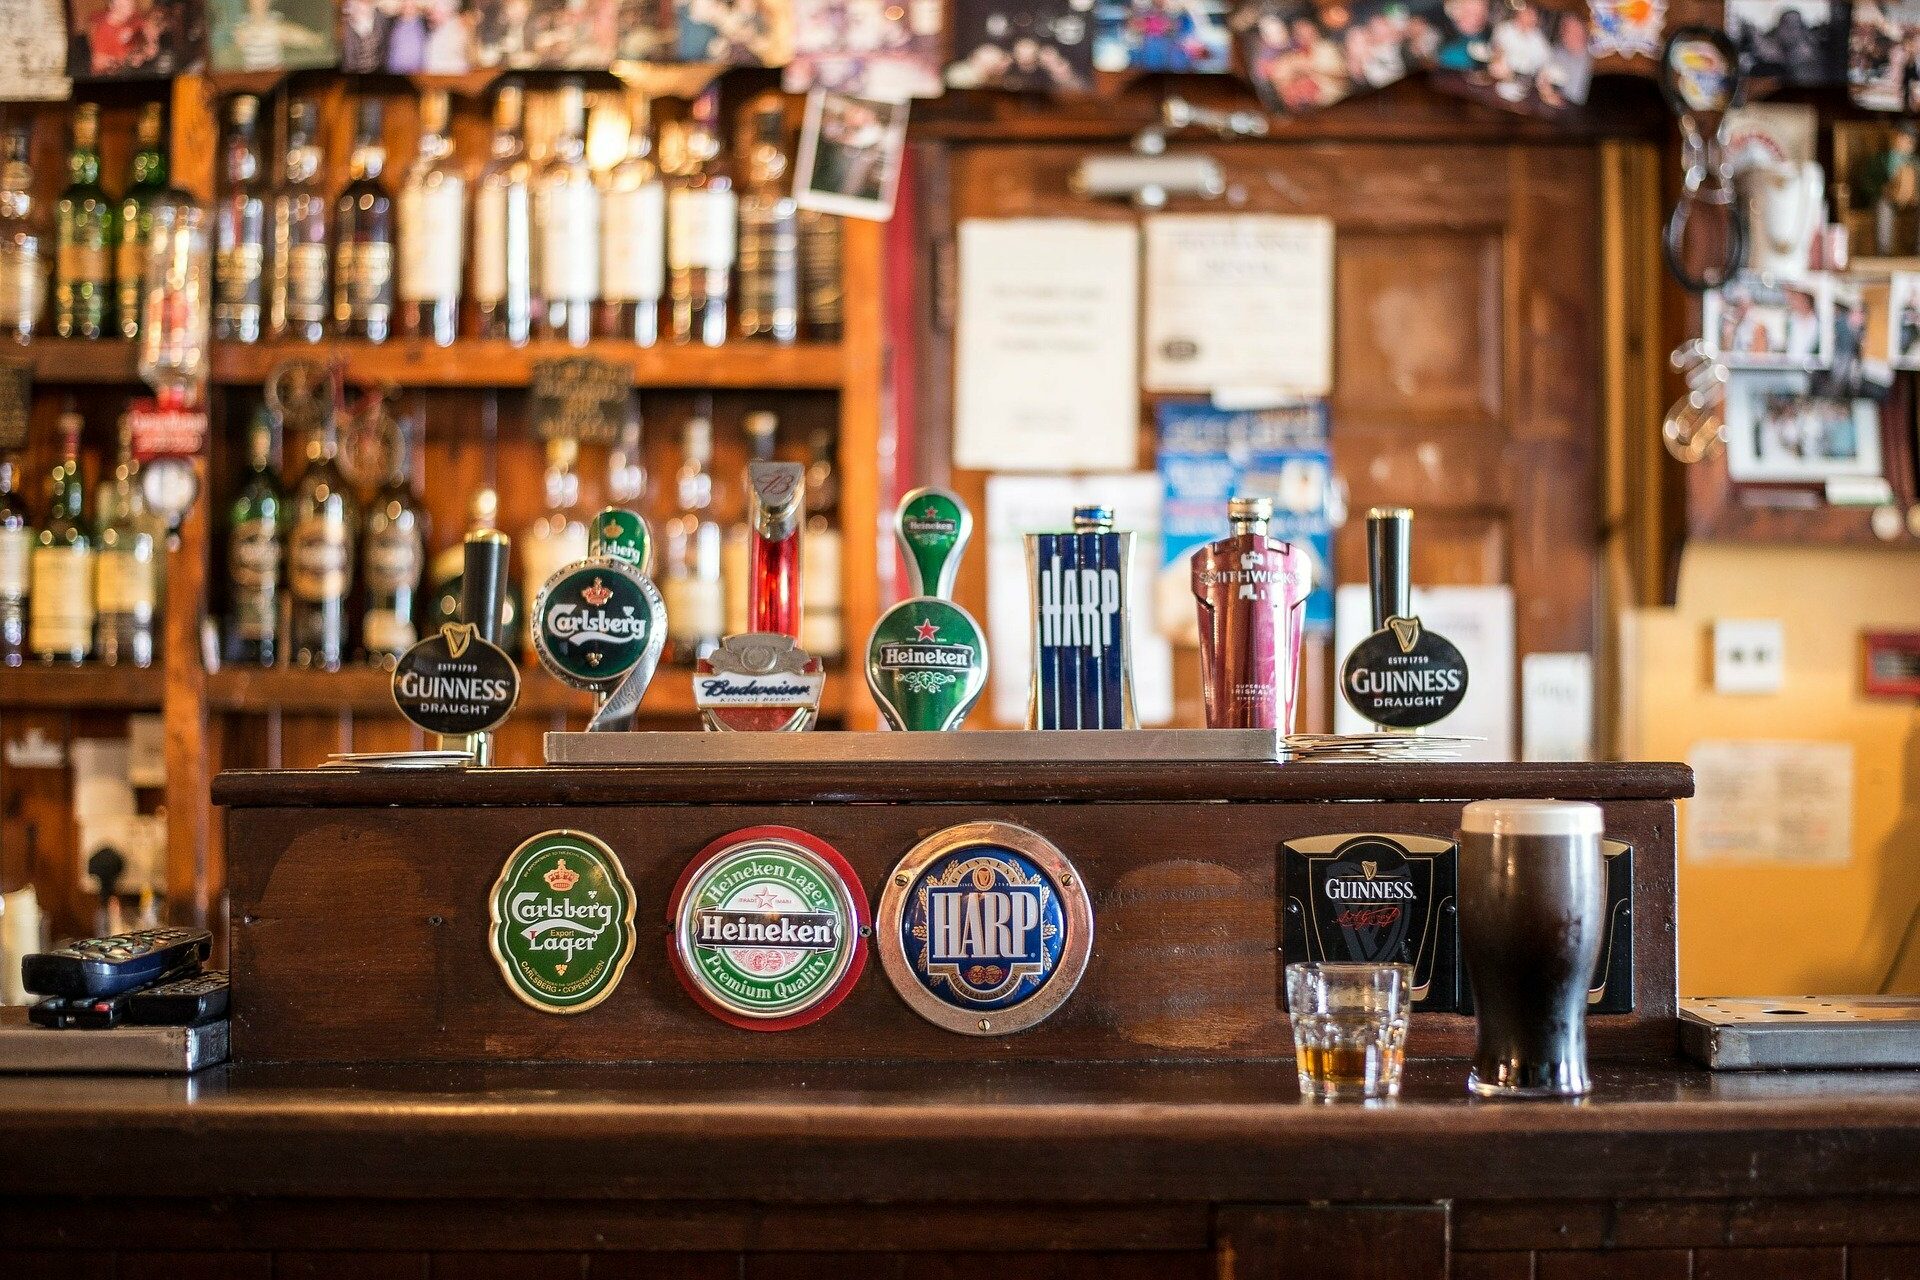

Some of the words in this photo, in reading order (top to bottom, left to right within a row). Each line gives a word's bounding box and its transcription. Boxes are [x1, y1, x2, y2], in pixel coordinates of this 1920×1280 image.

[910, 521, 953, 530] Heineken
[1042, 555, 1119, 658] HARP
[548, 604, 647, 641] Carlsberg
[886, 649, 967, 666] Heineken
[1409, 656, 1429, 664] 1759
[402, 672, 508, 701] GUINNESS
[702, 680, 810, 697] Budweiser
[1351, 668, 1461, 694] GUINNESS
[420, 702, 490, 716] DRAUGHT
[1374, 696, 1444, 707] DRAUGHT
[706, 861, 785, 903] Heineken
[786, 865, 828, 908] Lager
[951, 859, 1016, 884] GUINNESS
[1326, 878, 1414, 899] GUINNESS
[511, 891, 613, 926] Carlsberg
[550, 930, 575, 938] Export
[701, 915, 832, 943] Heineken
[932, 891, 1039, 959] HARP
[528, 930, 598, 963] Lager
[521, 960, 557, 993] CARLSBERG
[562, 959, 605, 994] COPENHAGEN
[705, 954, 771, 999] Premium
[774, 956, 828, 999] Quality
